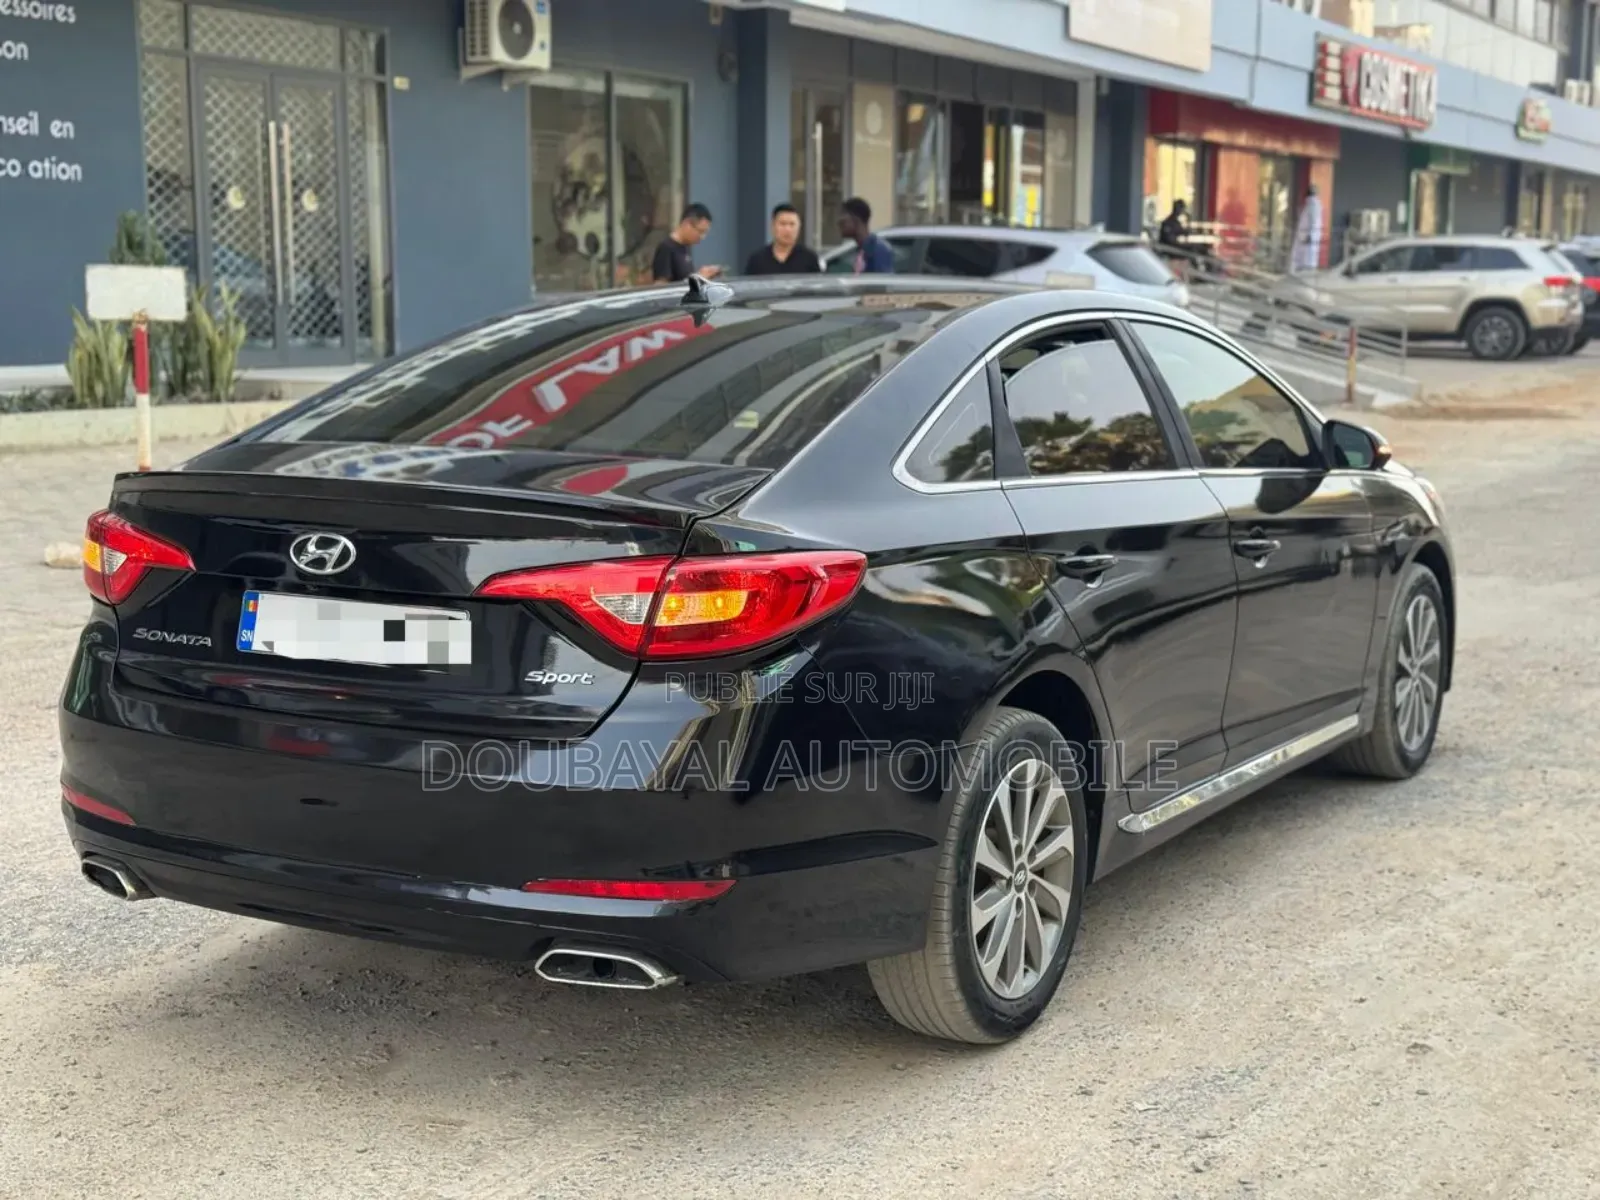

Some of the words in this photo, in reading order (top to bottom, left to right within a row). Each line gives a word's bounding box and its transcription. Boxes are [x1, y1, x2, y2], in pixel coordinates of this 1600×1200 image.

[50, 119, 75, 139] en
[132, 627, 212, 648] SONATA
[240, 629, 254, 643] SN
[524, 670, 594, 685] Sport
